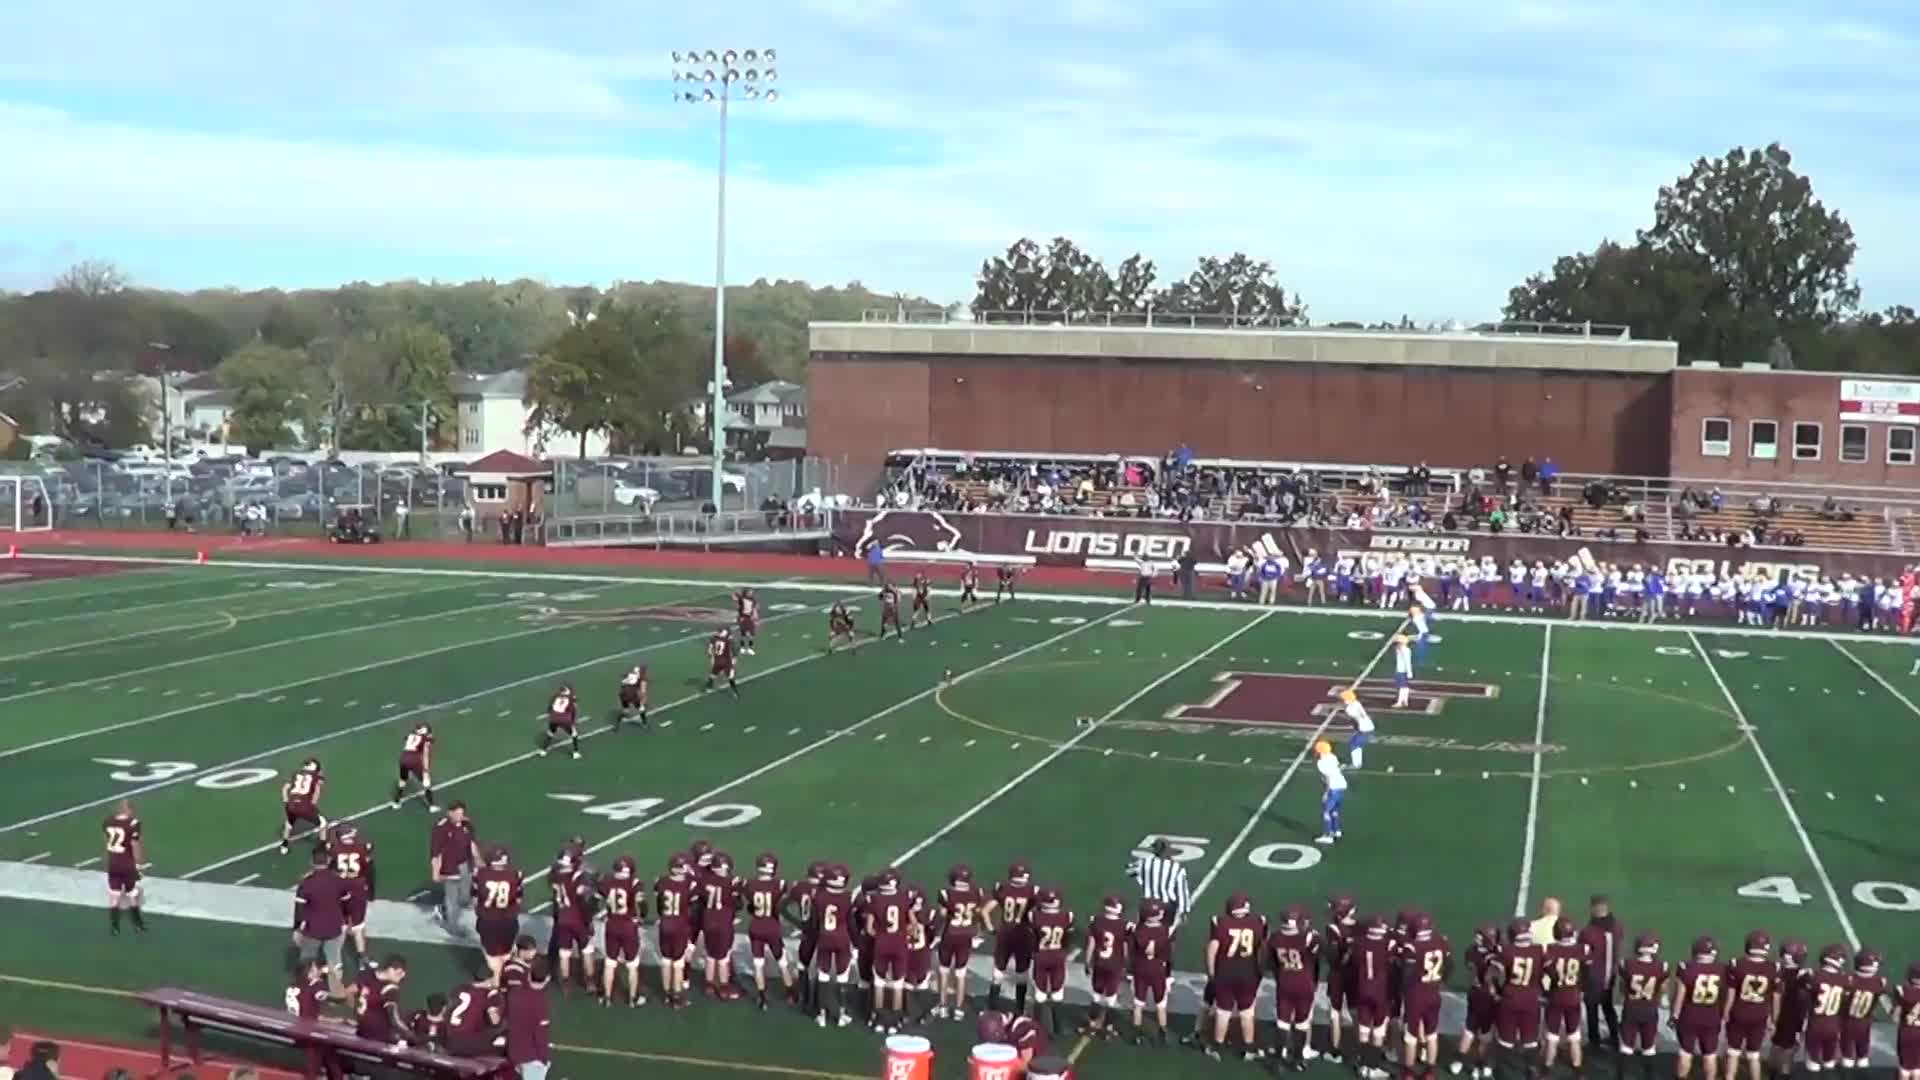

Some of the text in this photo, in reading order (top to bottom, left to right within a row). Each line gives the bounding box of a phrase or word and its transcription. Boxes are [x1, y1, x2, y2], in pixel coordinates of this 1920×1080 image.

[1025, 529, 1191, 558] LIONS DEN
[581, 798, 763, 827] 40
[337, 852, 361, 879] 55
[484, 880, 511, 908] 78
[663, 890, 682, 916] 31
[705, 885, 723, 910] 71
[753, 891, 772, 917] 91
[824, 904, 838, 931] 6
[887, 905, 900, 933] 9
[950, 903, 976, 927] 35
[1004, 895, 1027, 923] 87
[1099, 931, 1115, 959] 3
[1228, 928, 1254, 957] 79
[1365, 950, 1374, 980] 1
[1511, 956, 1534, 986] 51
[1555, 957, 1580, 987] 18
[1629, 974, 1657, 1000] 54
[1815, 983, 1843, 1016] 30
[450, 991, 473, 1025] 2
[1850, 991, 1874, 1018] 10
